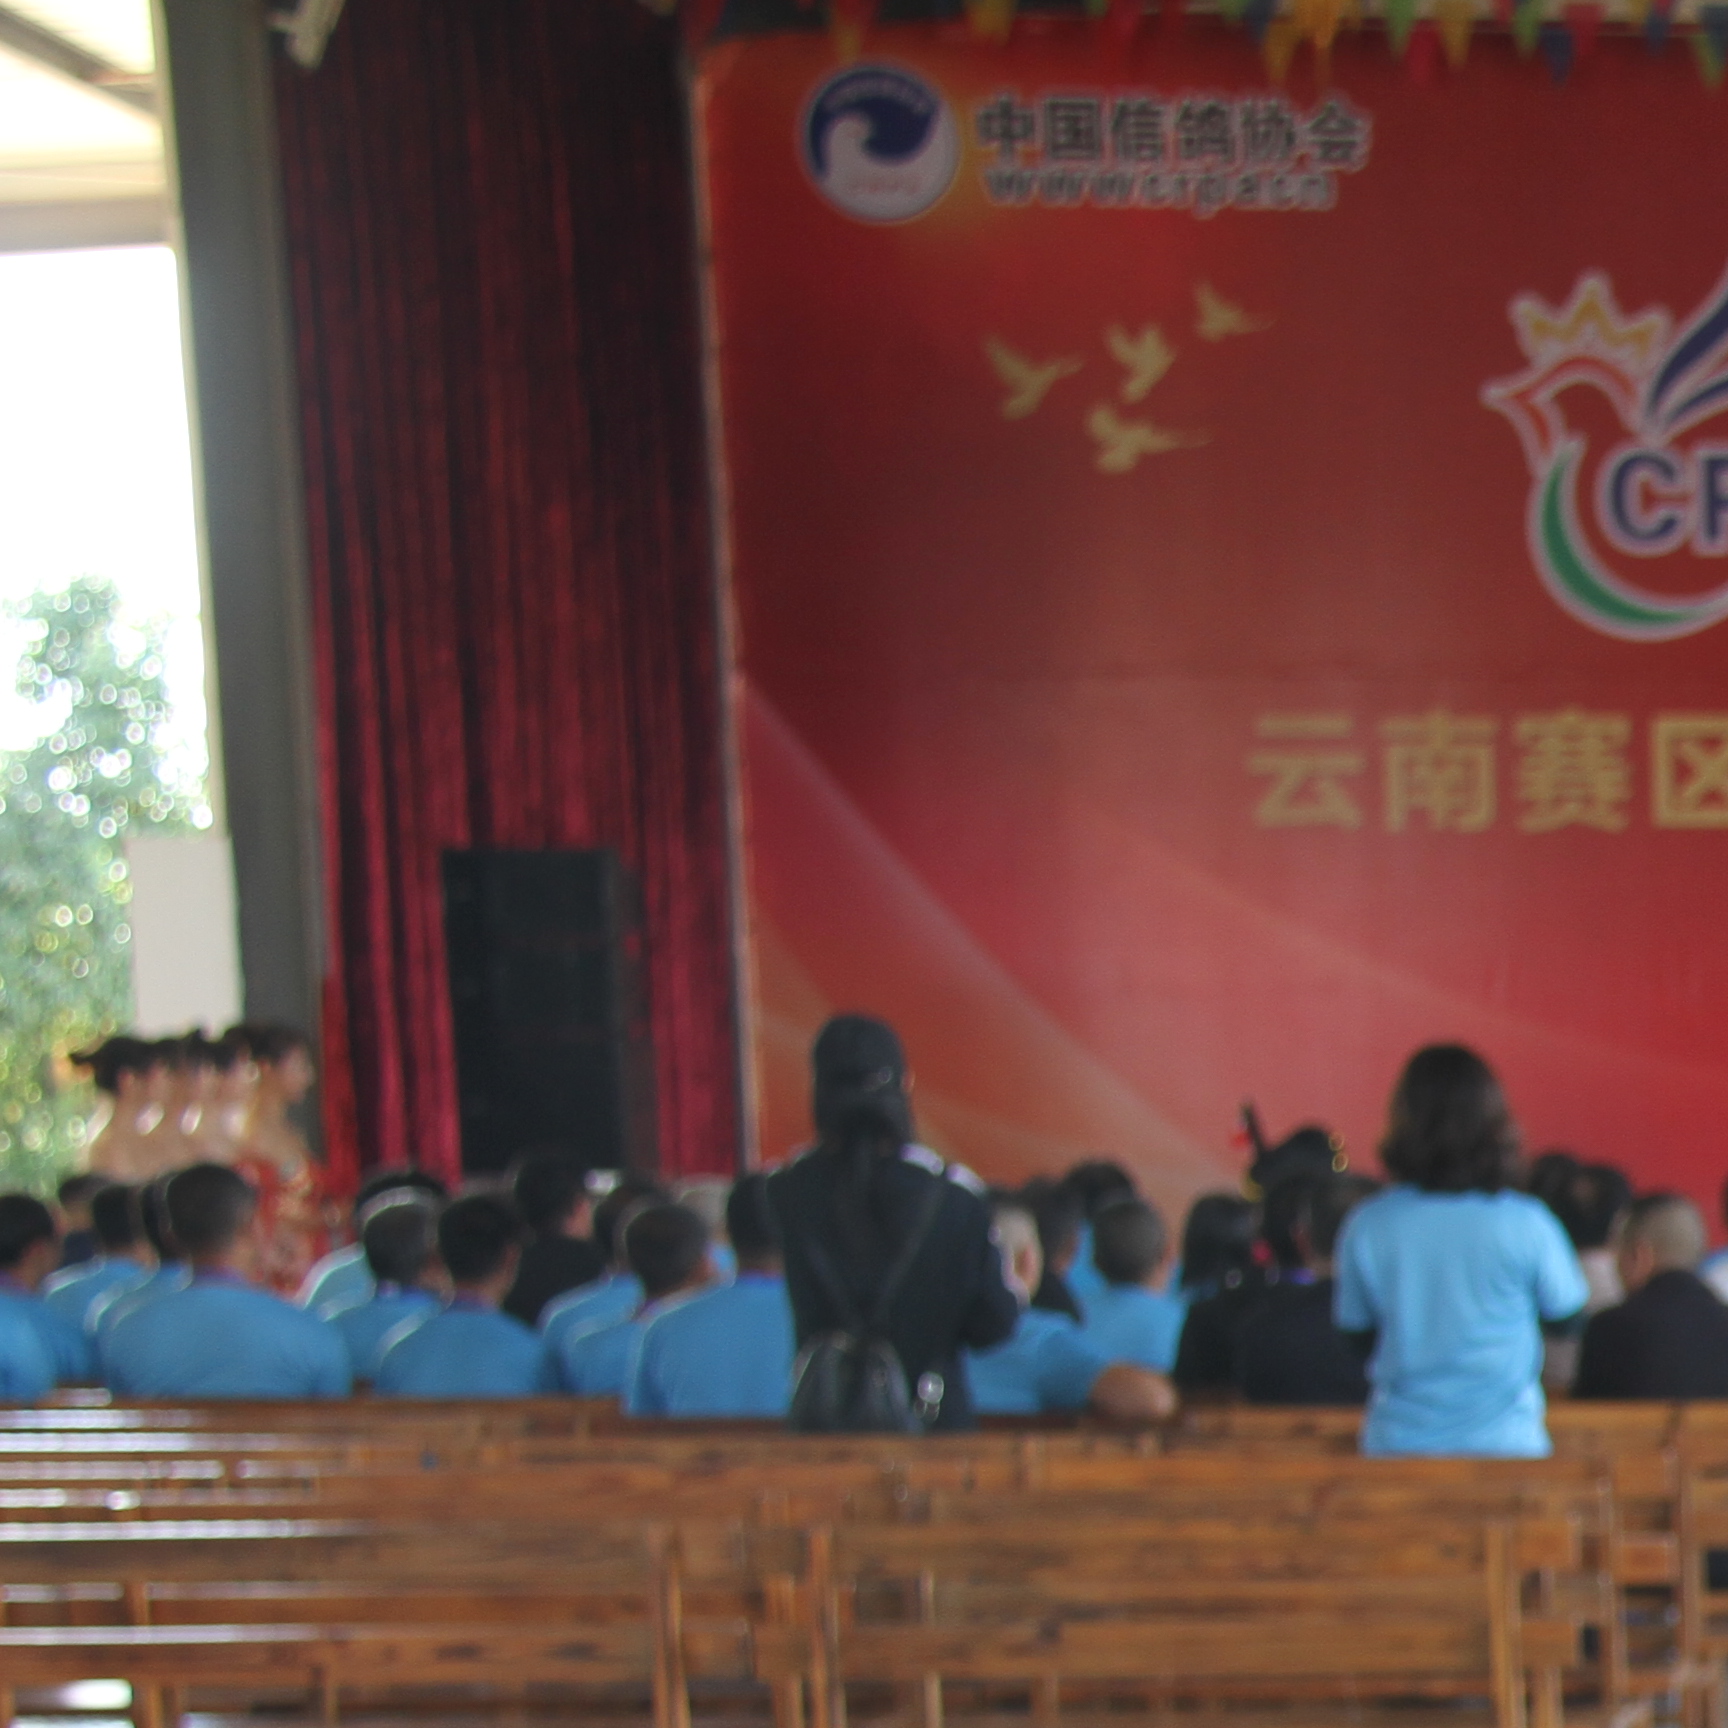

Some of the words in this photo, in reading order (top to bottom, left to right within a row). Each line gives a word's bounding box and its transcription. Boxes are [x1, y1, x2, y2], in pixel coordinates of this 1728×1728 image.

[976, 94, 1366, 165] 中国信鸽协会
